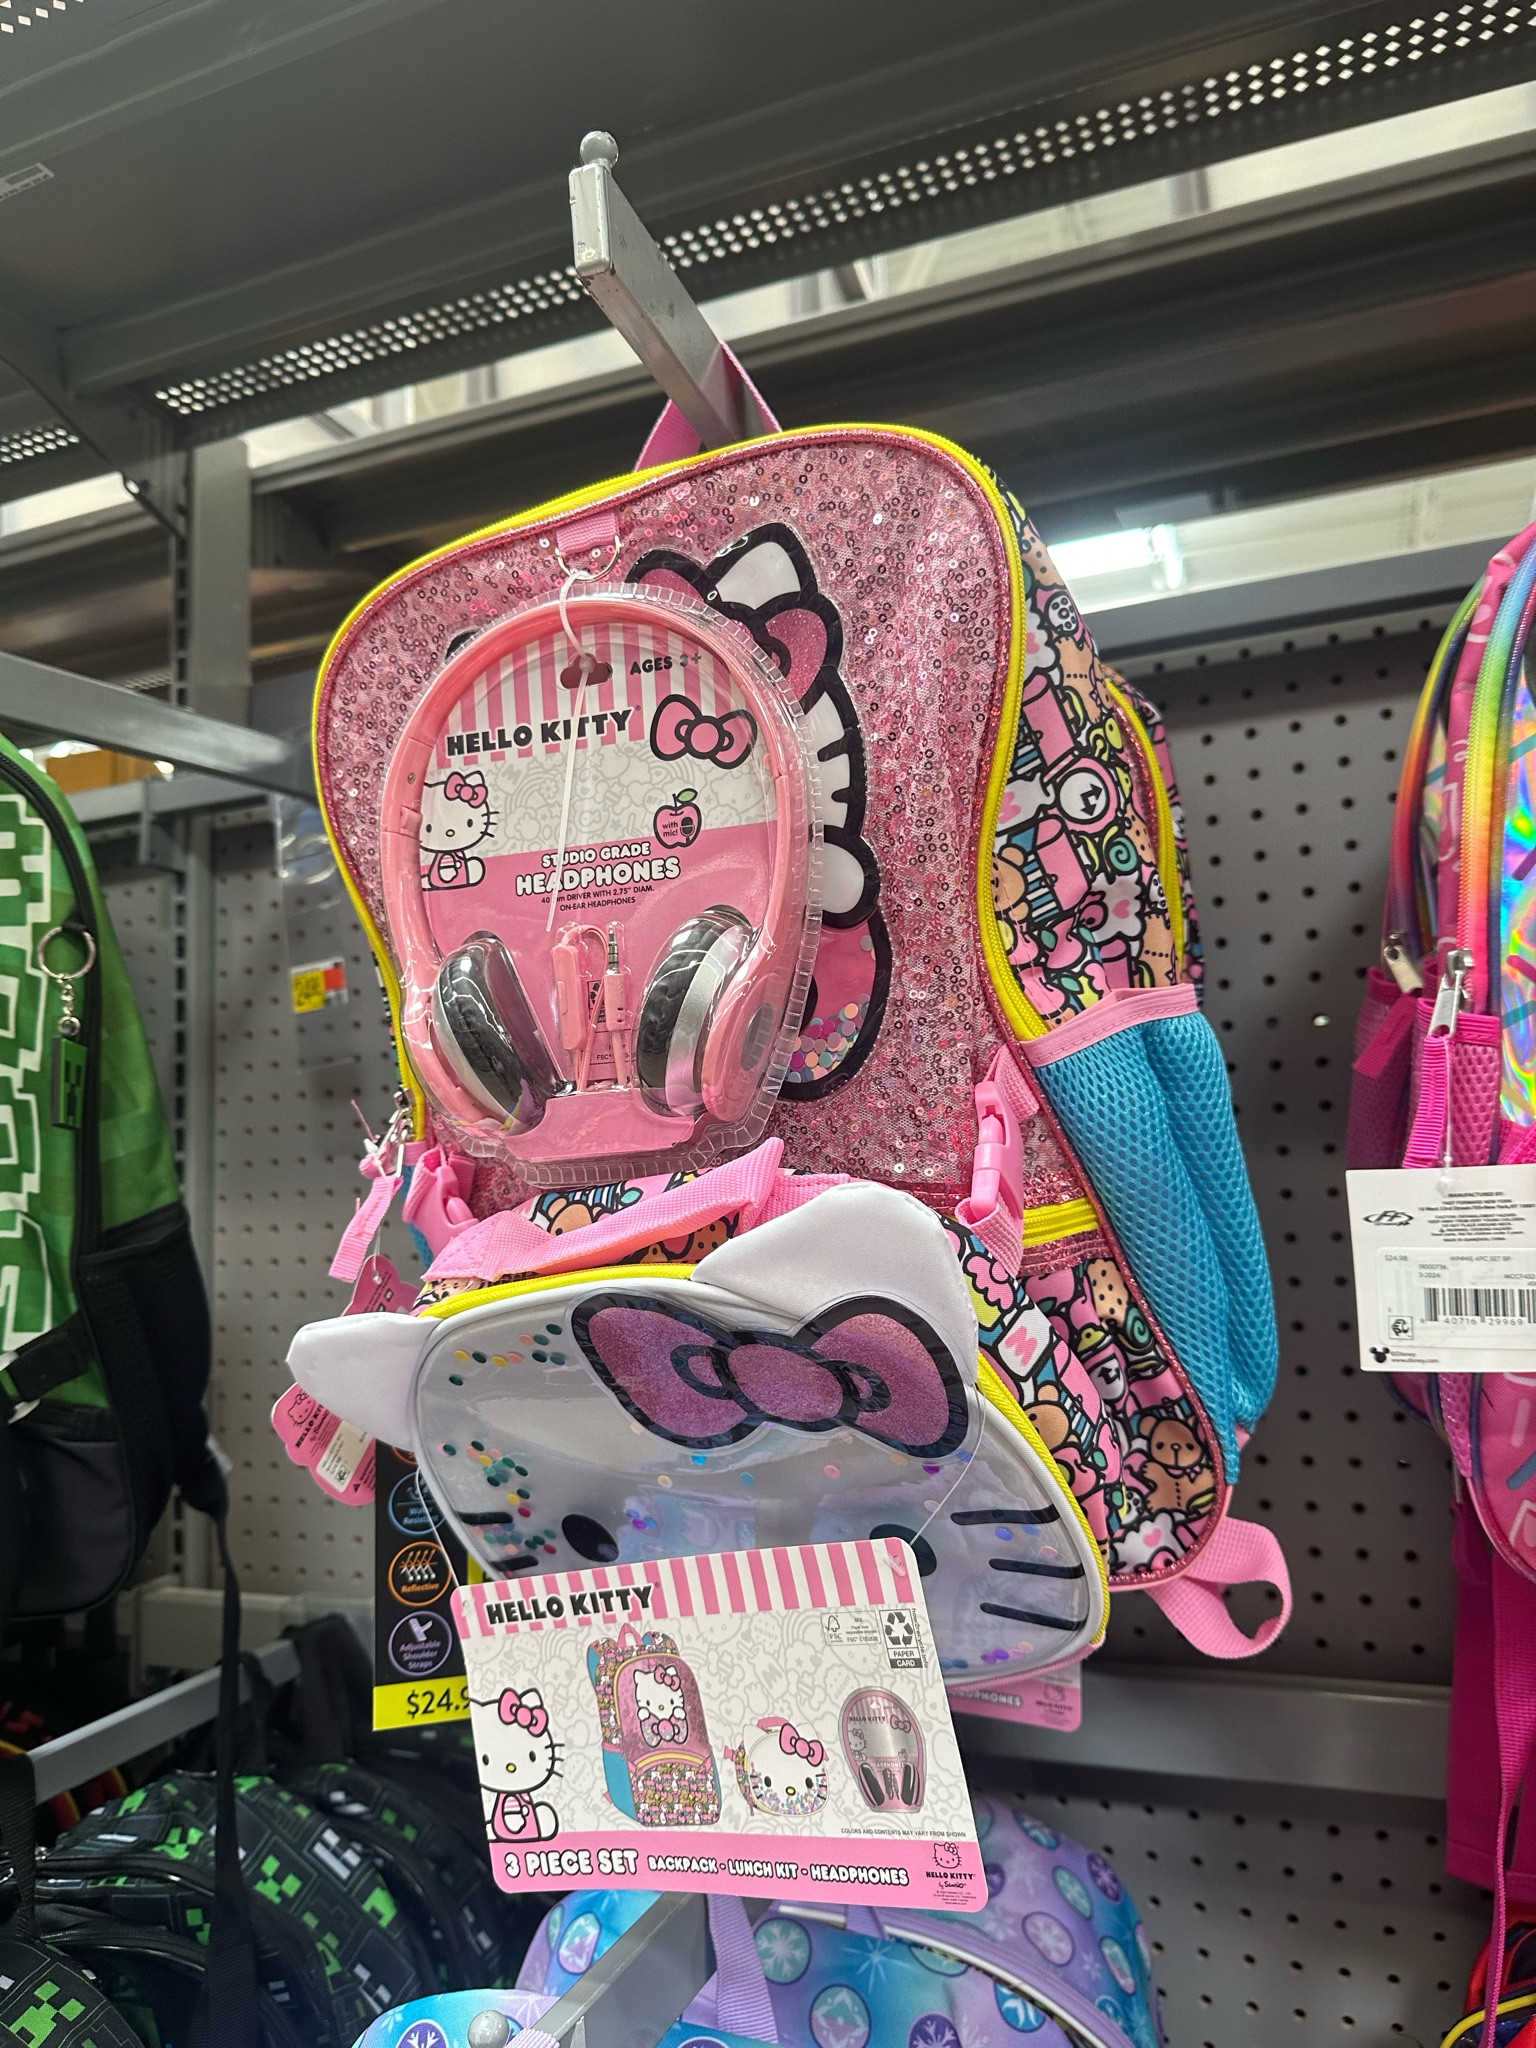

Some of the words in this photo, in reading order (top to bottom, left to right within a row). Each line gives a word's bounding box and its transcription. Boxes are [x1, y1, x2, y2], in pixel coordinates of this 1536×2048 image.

[629, 655, 673, 676] AGES
[446, 725, 534, 757] HELLO
[540, 708, 632, 744] KITTY
[661, 821, 679, 831] with
[662, 829, 679, 838] mic!
[541, 847, 598, 869] STUDIO
[599, 841, 652, 862] GRADE
[515, 855, 682, 897] HEADPHONES
[566, 892, 592, 902] DRIVER
[592, 888, 612, 899] WITH
[633, 884, 655, 894] DIAM.
[559, 902, 587, 912] ON-EAR
[587, 896, 637, 909] HEADPHONES
[400, 1583, 440, 1593] Reflective
[486, 1595, 565, 1625] HELLO
[569, 1586, 652, 1616] KITTY
[399, 1639, 442, 1652] Adjustable
[402, 1649, 438, 1661] Shoulder
[893, 1650, 915, 1658] PAPER
[408, 1660, 433, 1670] Straps
[896, 1659, 916, 1667] CARD
[504, 1852, 521, 1878] 3
[525, 1850, 594, 1877] PIECE
[597, 1848, 639, 1876] SET
[647, 1855, 718, 1874] BACKPACK
[727, 1858, 773, 1878] LUNCH
[774, 1861, 799, 1880] KIT
[809, 1863, 910, 1886] HEADPHONES
[925, 1871, 949, 1879] HELLO
[949, 1872, 974, 1880] KITTY
